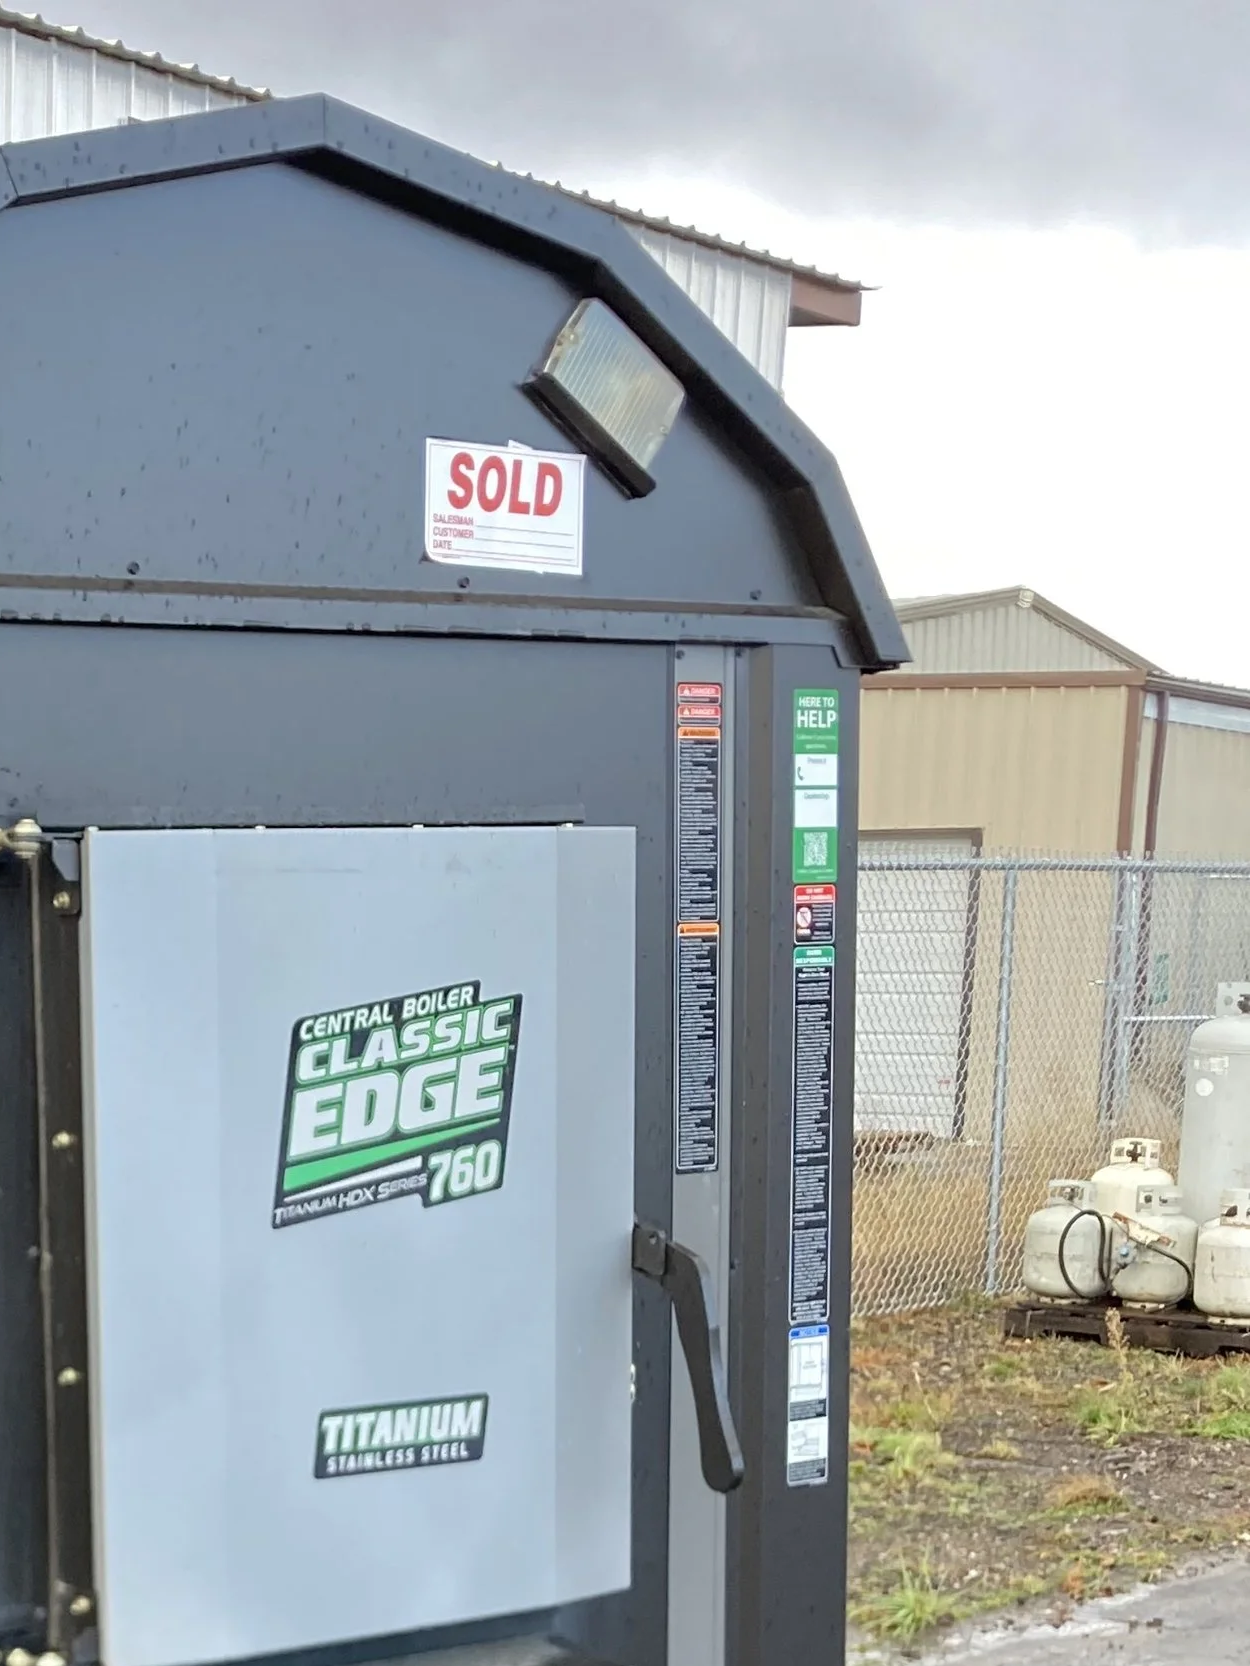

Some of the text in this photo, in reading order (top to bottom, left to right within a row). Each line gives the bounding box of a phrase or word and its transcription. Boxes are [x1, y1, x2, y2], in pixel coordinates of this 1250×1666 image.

[447, 451, 563, 517] SOLD
[432, 513, 474, 526] SALESMAN
[432, 526, 474, 539] CUSTOMER
[432, 539, 453, 550] DATE
[796, 709, 837, 729] HELP
[798, 696, 835, 708] HERE TO
[300, 984, 474, 1040] CENTRAL BOILER
[296, 999, 514, 1083] CLASSIC
[288, 1045, 508, 1160] EDGE
[428, 1138, 503, 1204] 760
[338, 1184, 375, 1209] HDX
[377, 1172, 427, 1199] SERIES
[322, 1398, 486, 1455] TITANIUM
[325, 1441, 470, 1475] STAINLESS STEEL
